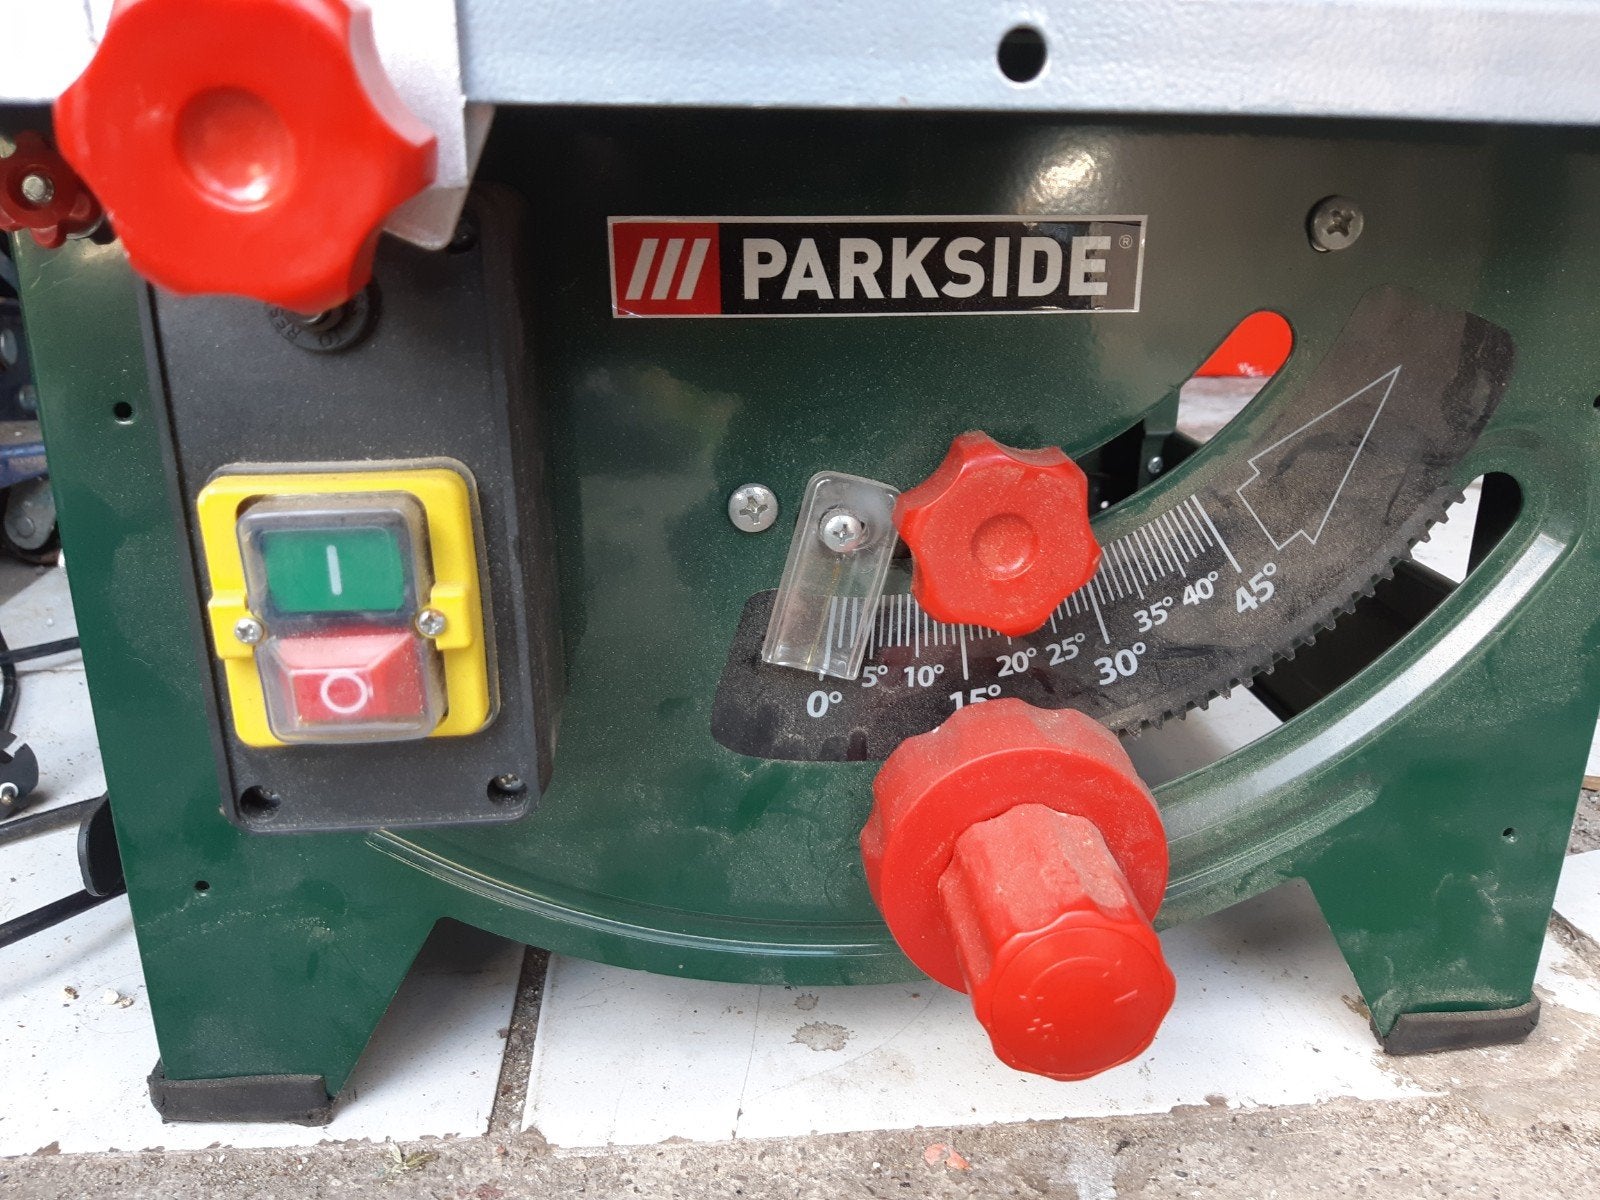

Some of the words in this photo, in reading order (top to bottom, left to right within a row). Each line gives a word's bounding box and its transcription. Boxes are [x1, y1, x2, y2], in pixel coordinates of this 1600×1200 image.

[742, 236, 1112, 300] PARKSIDE
[861, 664, 888, 688] 5°
[903, 664, 945, 688] 10°
[995, 647, 1037, 678] 20°
[1045, 632, 1086, 667] 25°
[1093, 642, 1147, 686] 30°
[1132, 596, 1174, 634] 35°
[1181, 571, 1219, 608] 40°
[1234, 562, 1279, 615] 45°
